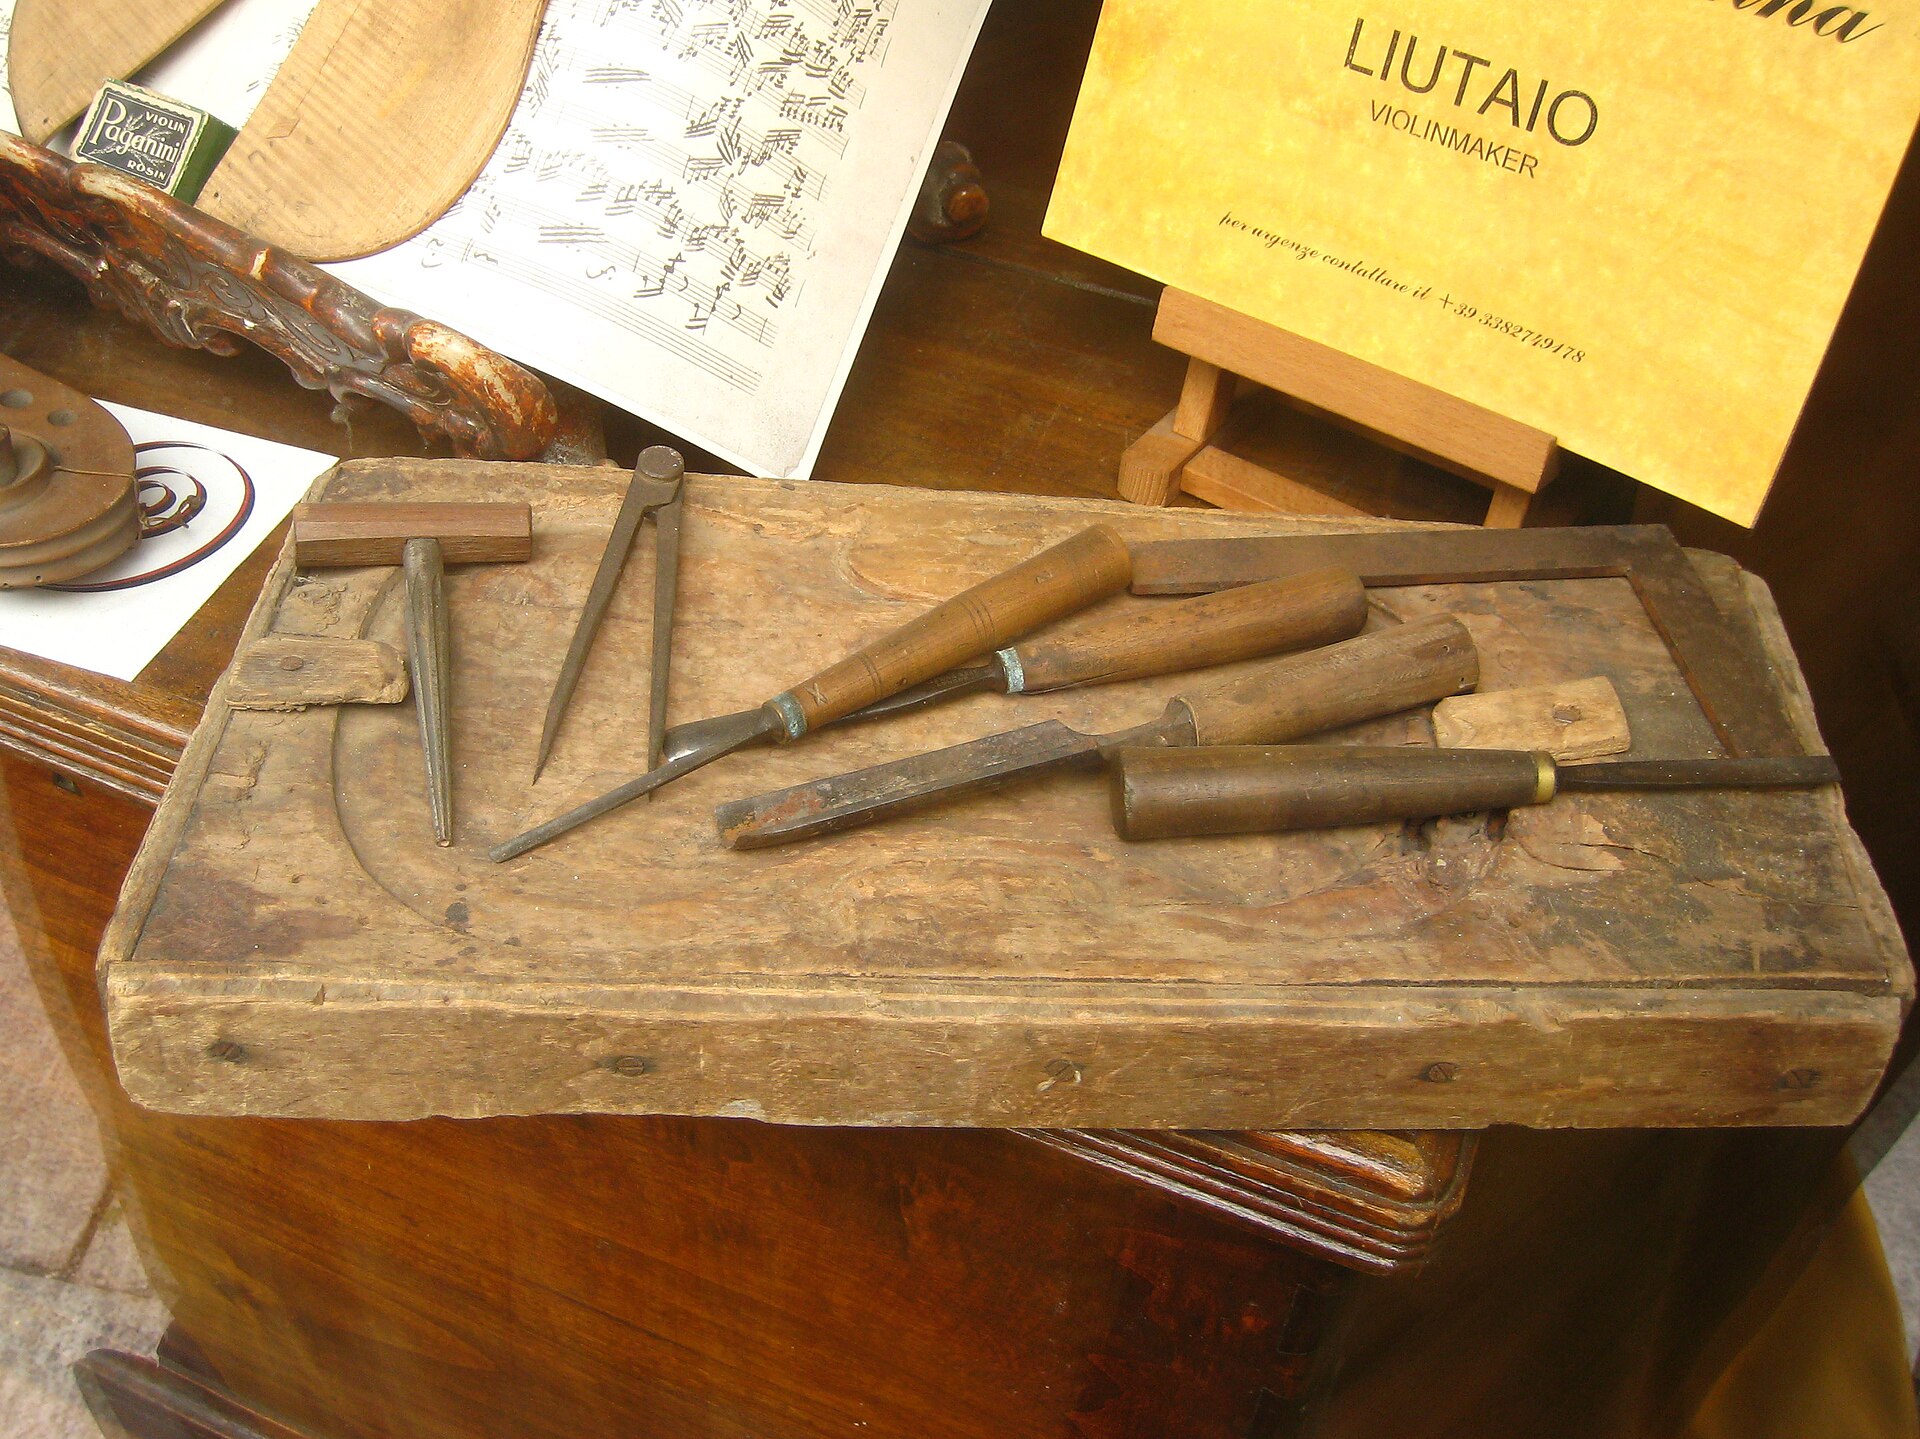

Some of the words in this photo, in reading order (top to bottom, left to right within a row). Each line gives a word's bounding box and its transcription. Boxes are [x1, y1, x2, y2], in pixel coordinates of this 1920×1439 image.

[1344, 17, 1598, 147] LIUTAIO
[89, 98, 181, 163] Paganini
[144, 111, 187, 134] VIOLIN
[1371, 99, 1539, 178] VIOLINMAKER
[127, 160, 167, 181] ROSIN
[1218, 211, 1251, 231] per
[1251, 227, 1321, 261] urgenze
[1322, 253, 1413, 293] contattare
[1412, 286, 1433, 300] il
[1439, 293, 1477, 319] +39
[1478, 312, 1586, 363] 3382749178
